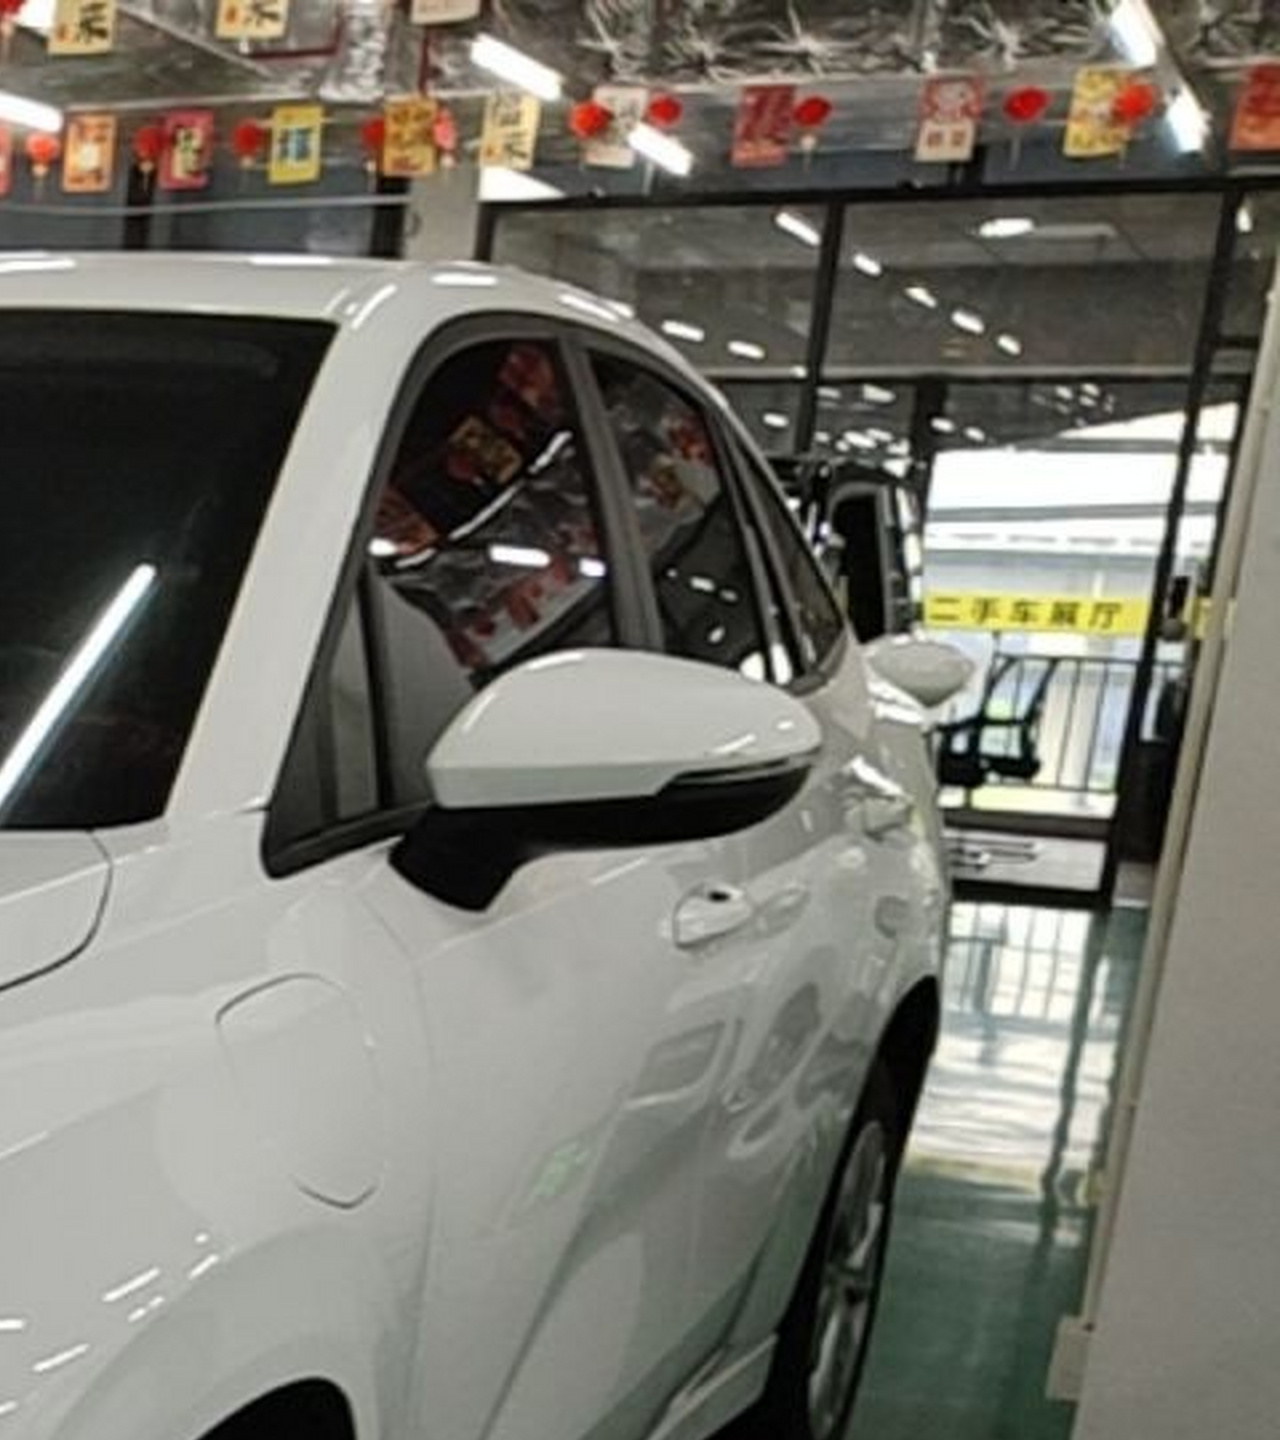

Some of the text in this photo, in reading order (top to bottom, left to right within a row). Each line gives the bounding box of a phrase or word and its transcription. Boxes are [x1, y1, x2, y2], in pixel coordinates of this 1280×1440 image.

[929, 596, 1124, 630] 二手车展厅
